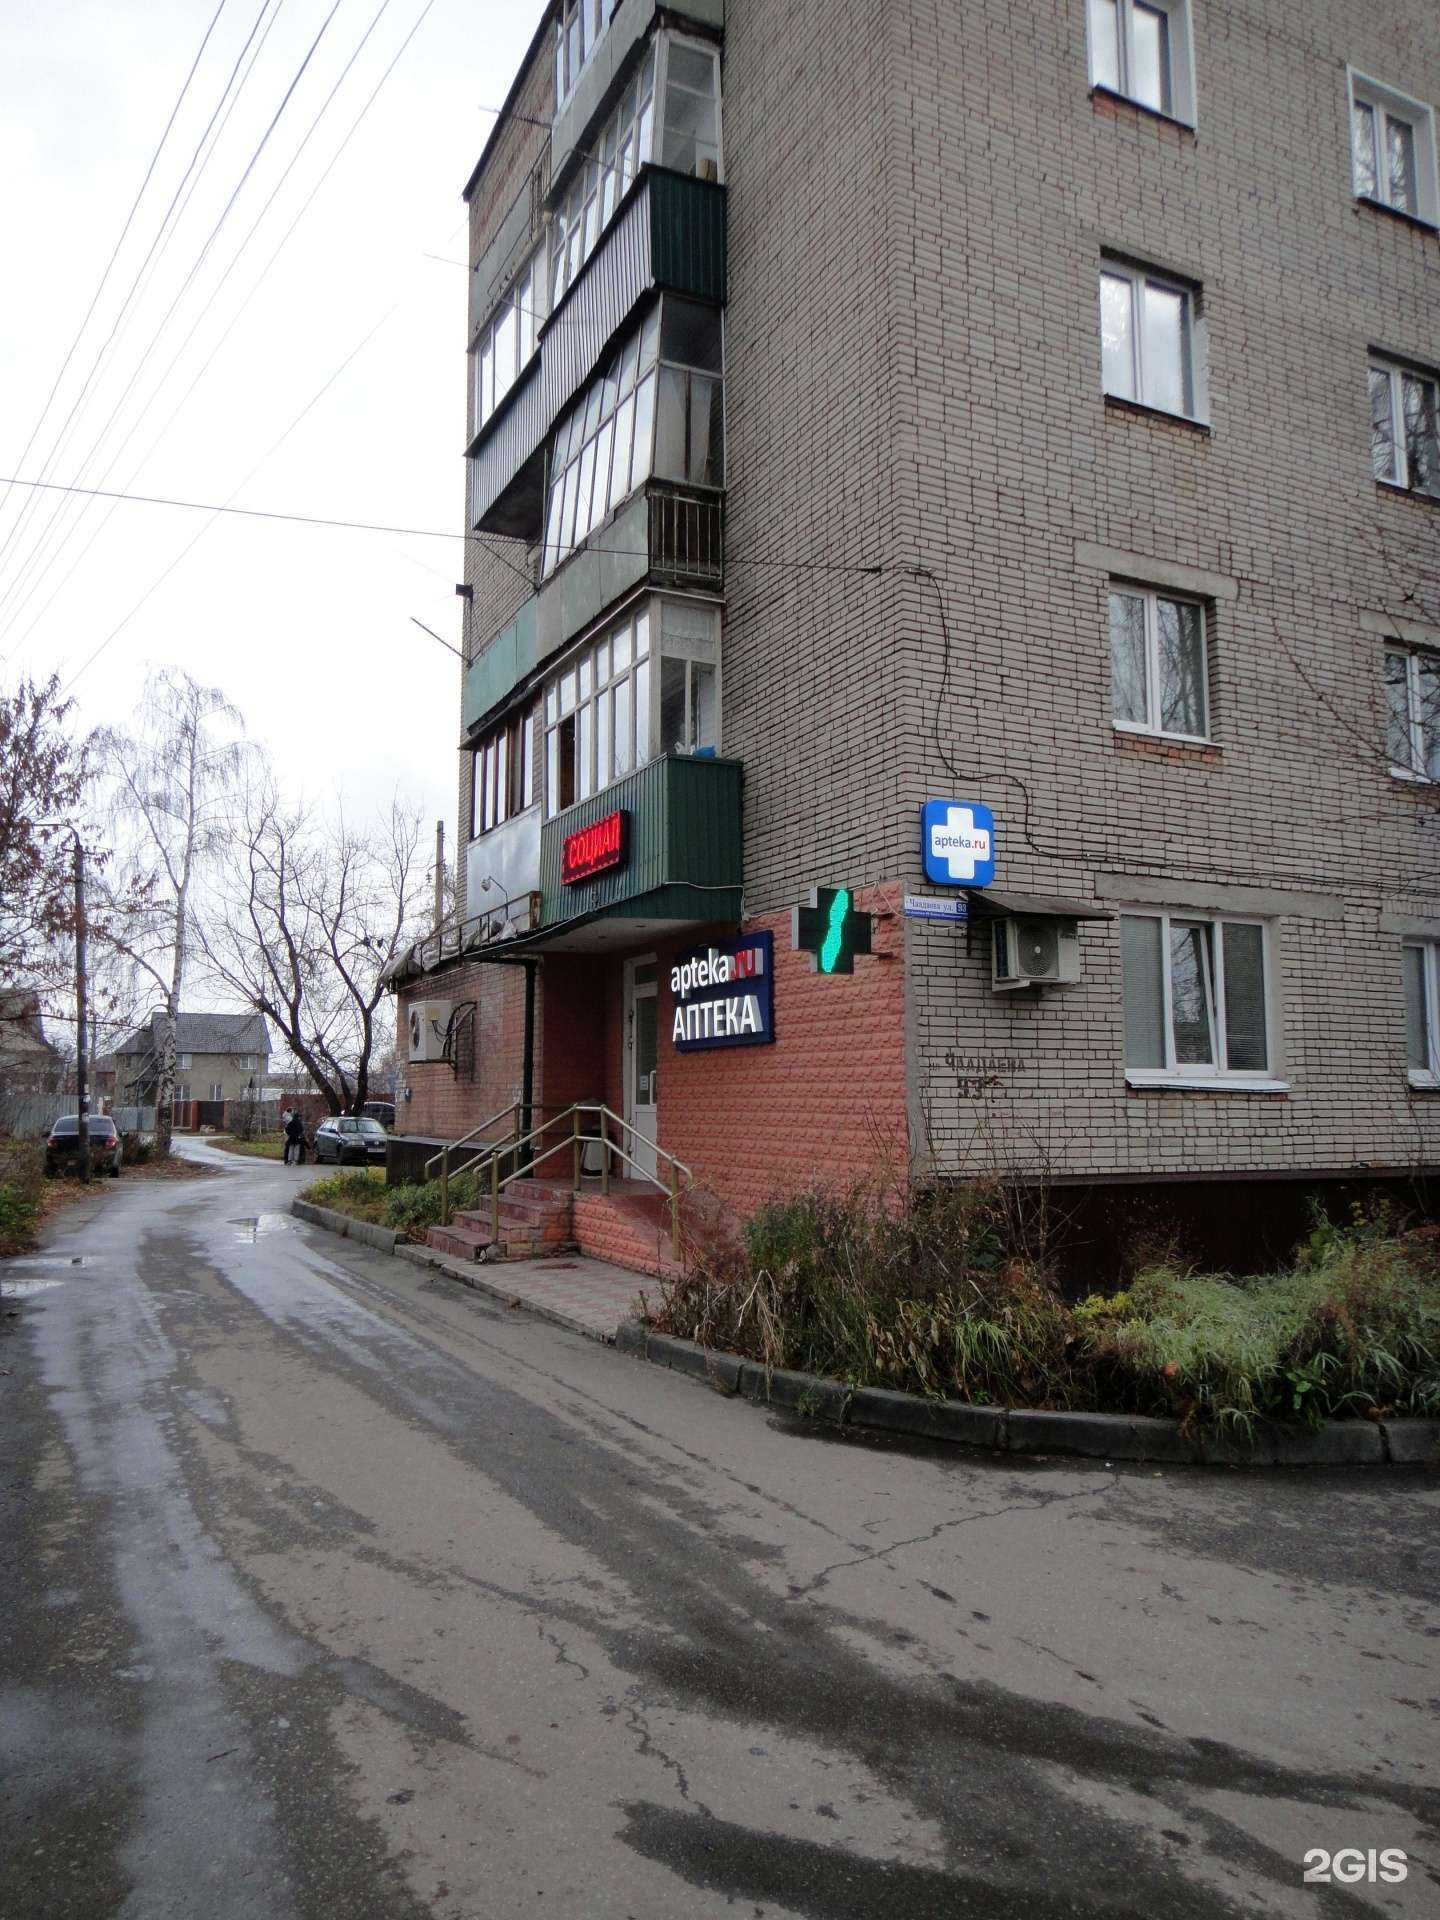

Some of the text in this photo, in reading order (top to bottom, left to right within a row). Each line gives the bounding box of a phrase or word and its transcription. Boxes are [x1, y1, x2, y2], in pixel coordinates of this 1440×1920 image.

[934, 835, 986, 850] apteka.ru
[957, 903, 967, 913] 93
[670, 947, 763, 999] apteka.ru
[672, 995, 763, 1042] АПТЕКА
